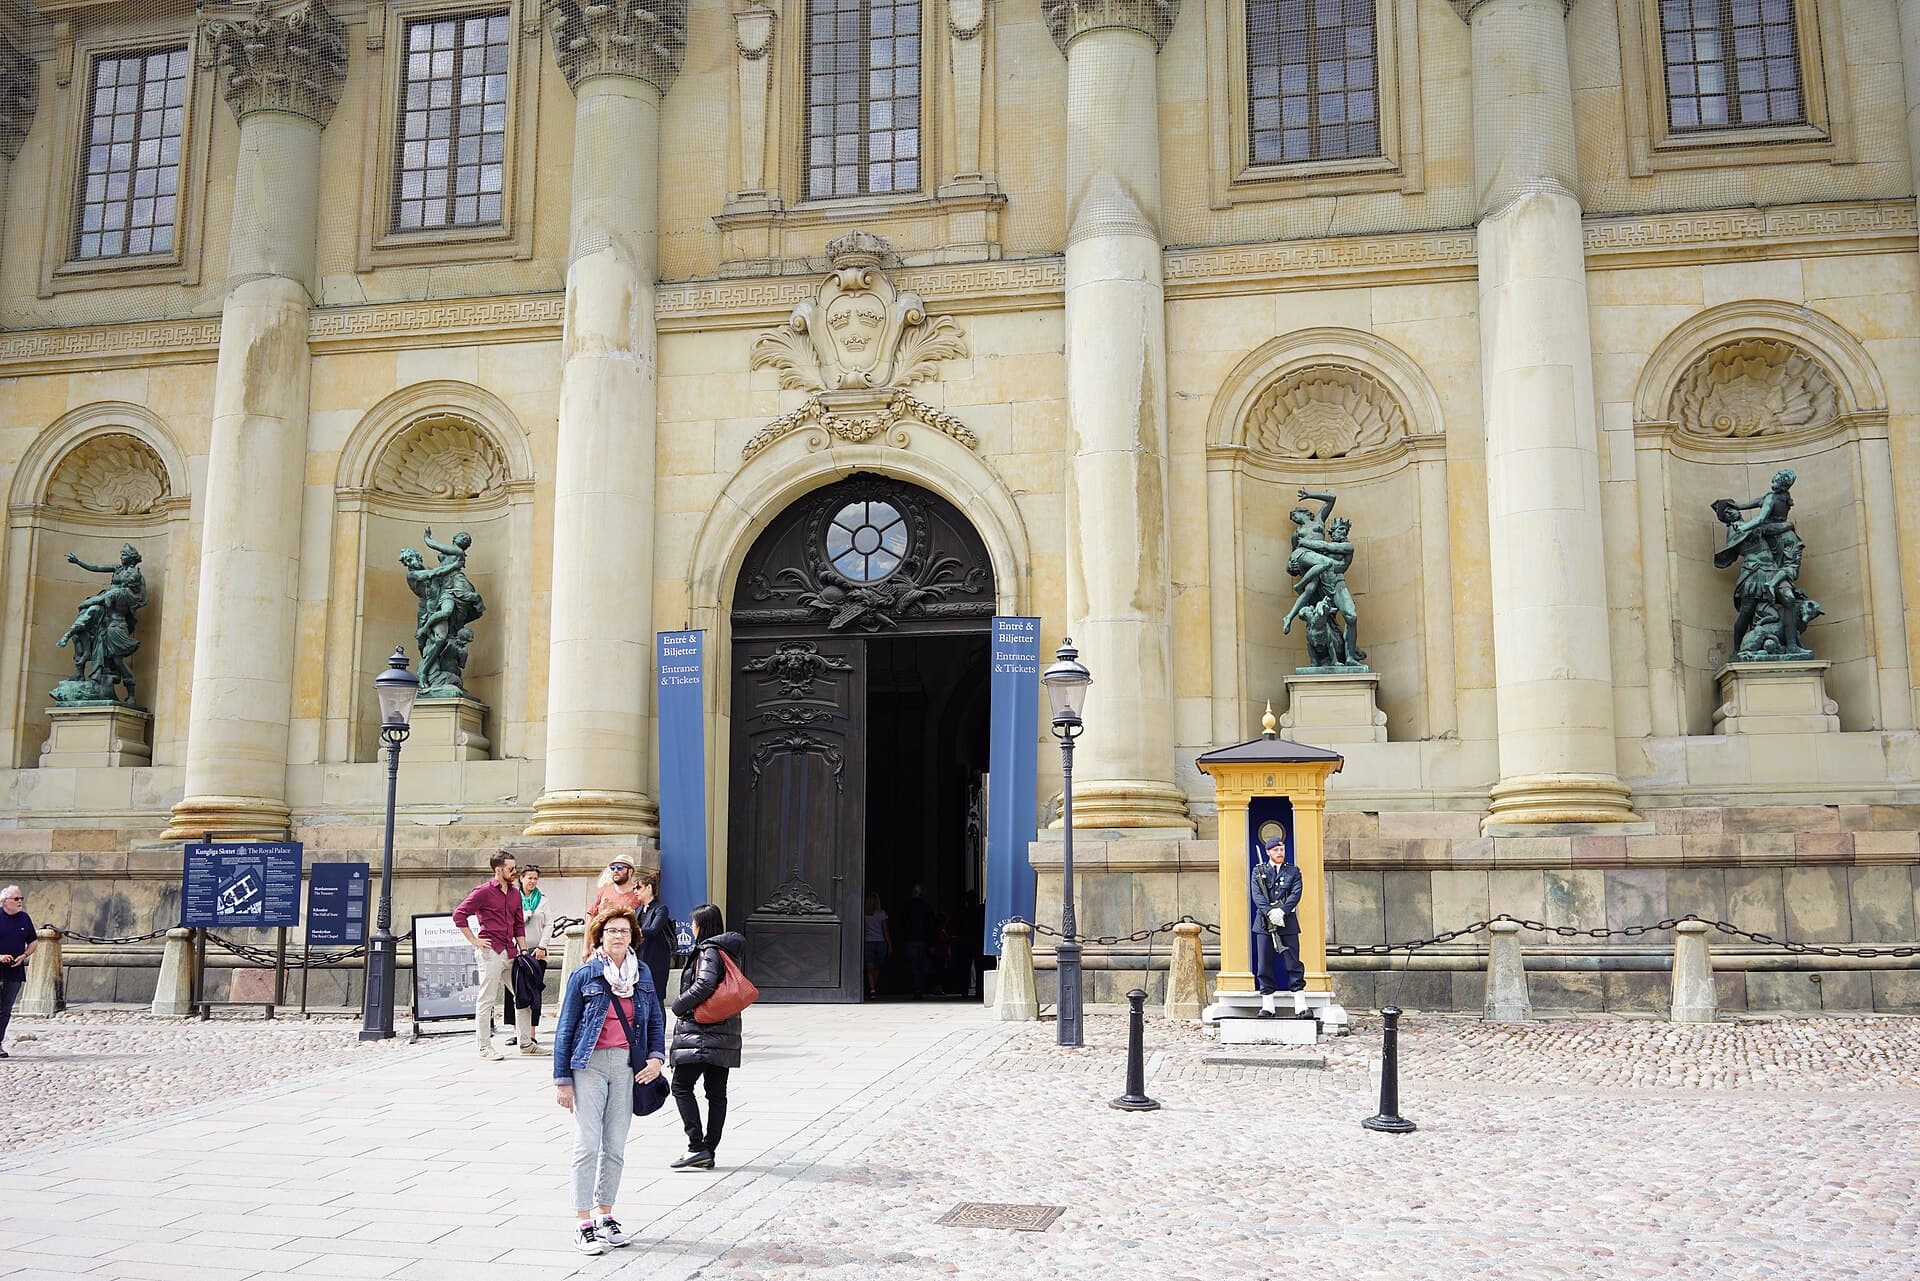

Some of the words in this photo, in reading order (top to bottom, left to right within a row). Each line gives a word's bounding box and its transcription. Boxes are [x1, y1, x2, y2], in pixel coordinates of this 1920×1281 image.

[999, 621, 1024, 630] Entré
[1025, 621, 1034, 631] &
[663, 635, 687, 645] Entré
[688, 634, 697, 643] &
[999, 633, 1034, 644] Biljetter
[663, 647, 697, 657] Biljetter
[996, 651, 1036, 661] Entrance
[661, 665, 699, 674] Entrance
[994, 663, 1003, 673] &
[1003, 664, 1036, 673] Tickets
[660, 677, 669, 686] &
[668, 675, 700, 685] Tickets
[195, 848, 218, 857] Kungliga
[258, 847, 274, 856] Royal
